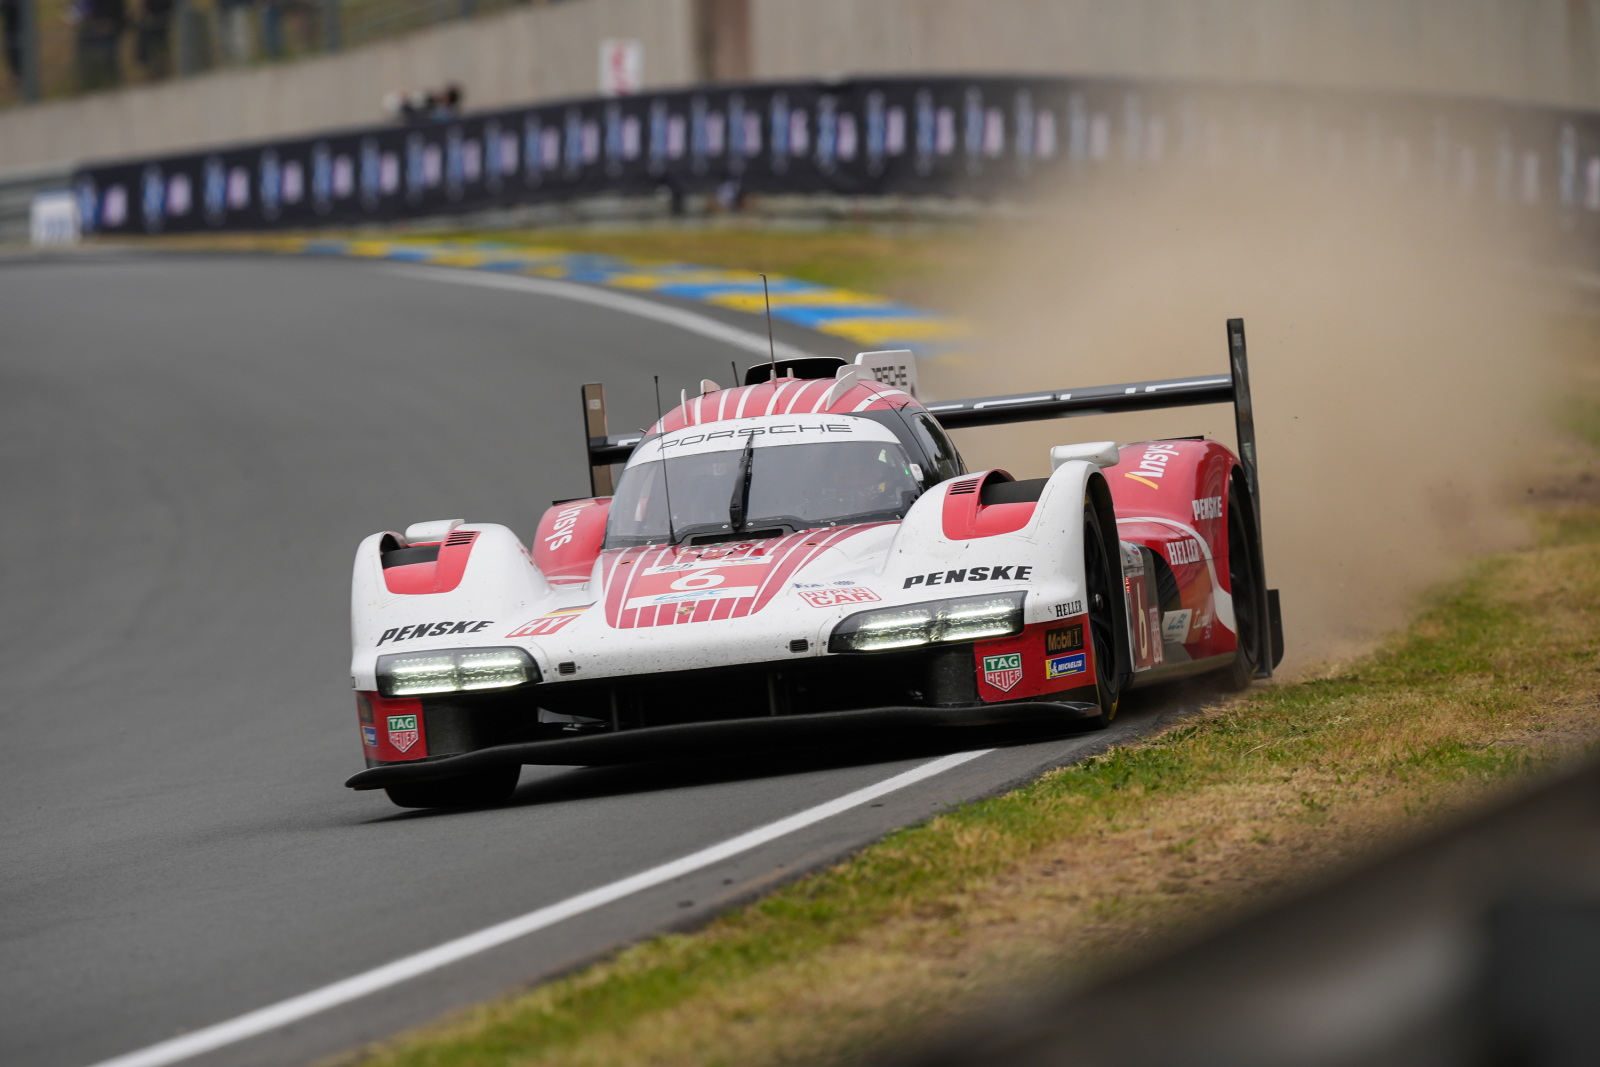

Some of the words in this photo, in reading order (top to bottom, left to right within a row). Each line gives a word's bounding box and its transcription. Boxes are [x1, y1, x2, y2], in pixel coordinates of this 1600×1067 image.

[657, 424, 852, 452] PORSCHE
[1124, 444, 1179, 490] Ansys
[1192, 496, 1223, 521] PENSKE
[545, 502, 596, 551] Ansys
[1166, 539, 1200, 565] HELLER
[670, 568, 725, 591] 6
[903, 566, 1033, 589] PENSKE
[804, 588, 866, 598] HYPER
[811, 593, 875, 605] CAR
[1055, 600, 1083, 617] HELLER
[509, 616, 578, 636] HY
[1137, 582, 1148, 660] 6
[376, 620, 495, 647] PENSKE
[1047, 630, 1072, 651] Mobil
[1073, 628, 1081, 647] 1
[987, 656, 1019, 670] TAG
[1057, 660, 1084, 671] MICHELIN
[987, 670, 1020, 689] HEUER
[389, 717, 415, 730] TAG
[389, 731, 417, 750] HEUER
